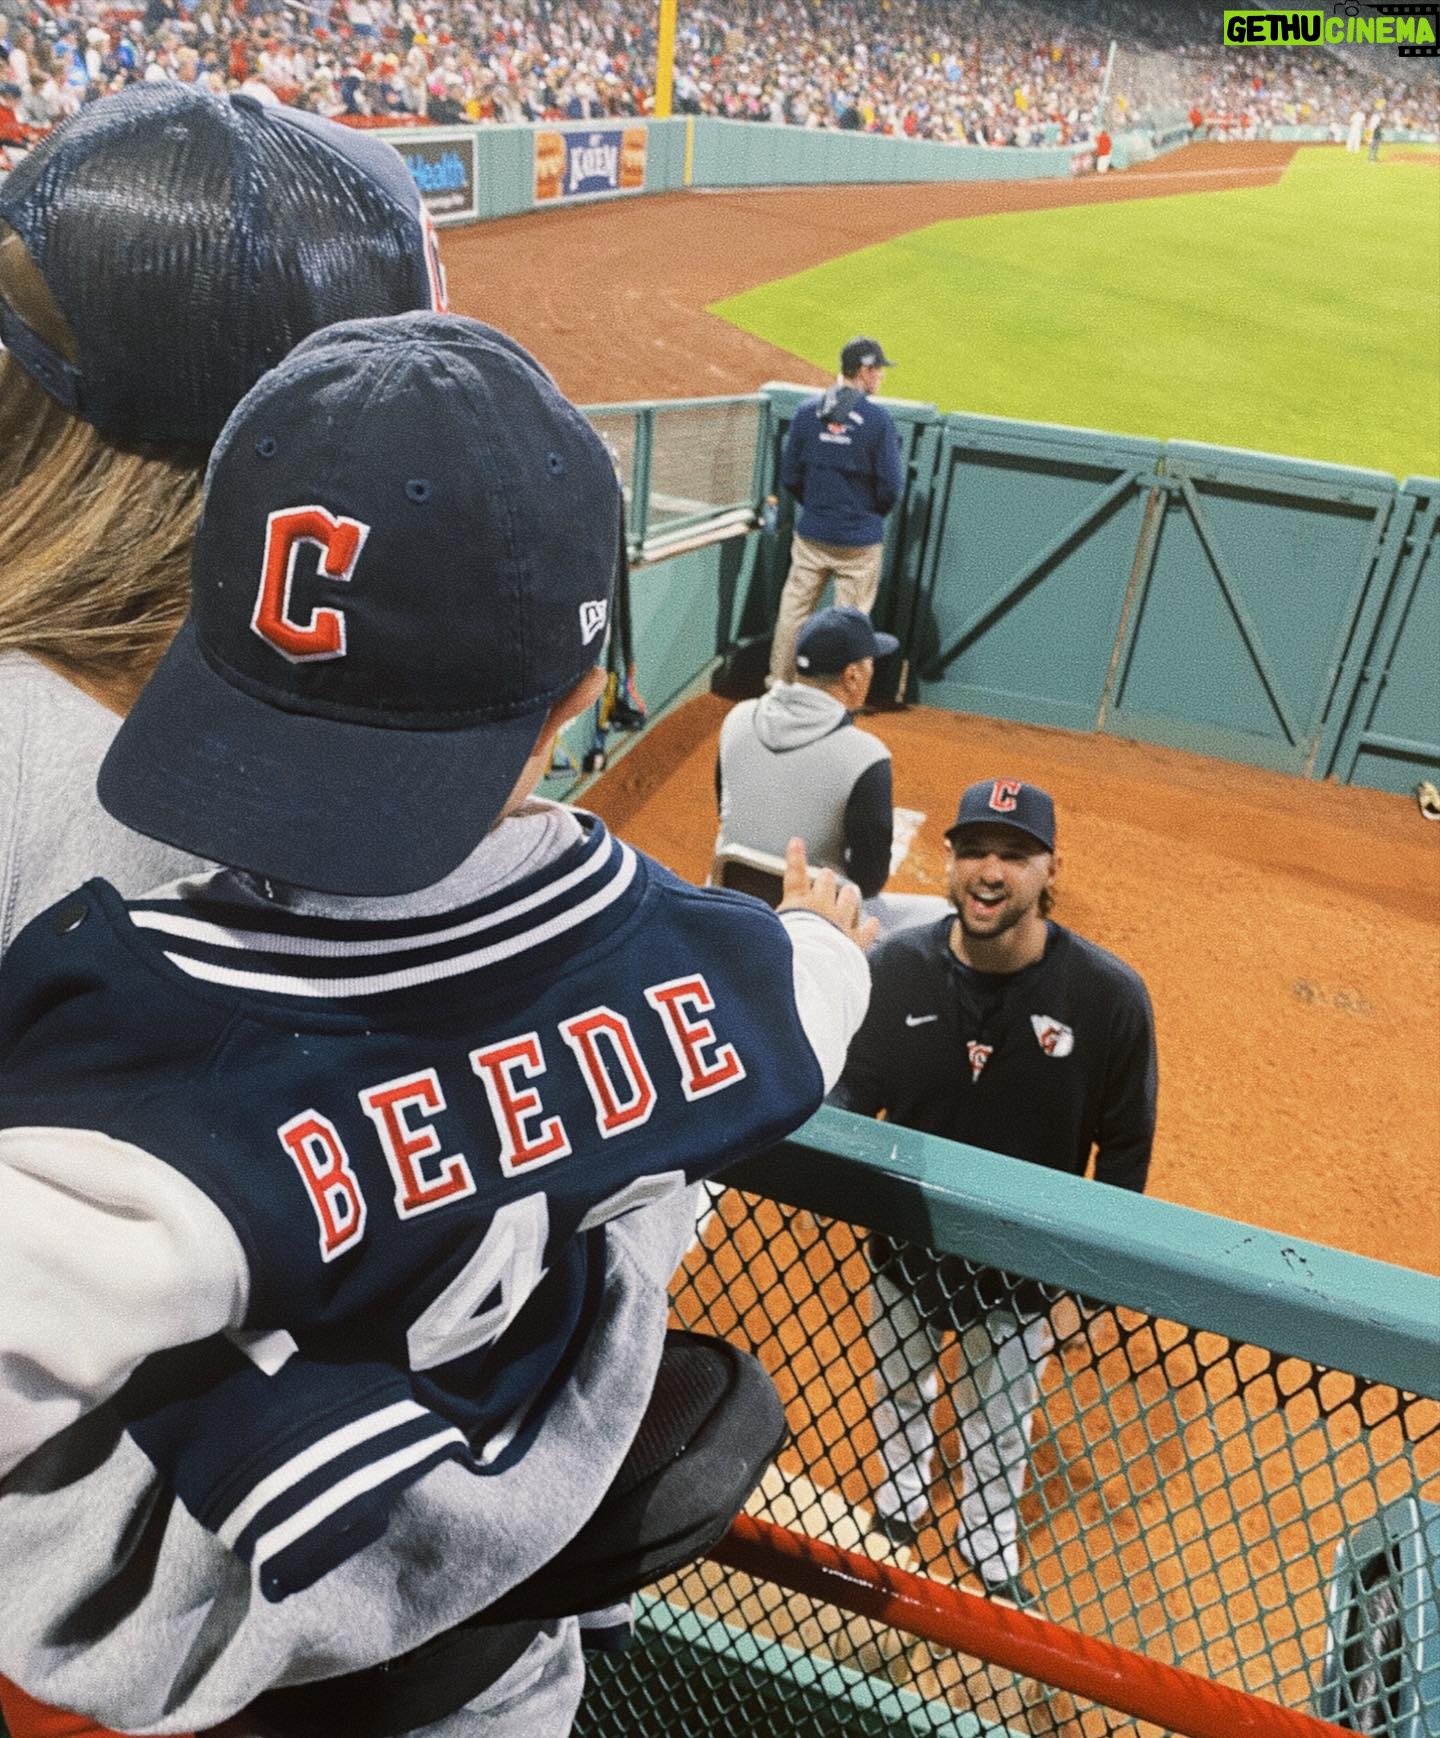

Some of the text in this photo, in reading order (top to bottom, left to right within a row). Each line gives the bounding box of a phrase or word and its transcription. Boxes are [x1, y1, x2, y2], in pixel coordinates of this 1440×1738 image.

[250, 505, 370, 664] C
[988, 777, 1021, 812] C
[277, 973, 746, 1263] BEEDE
